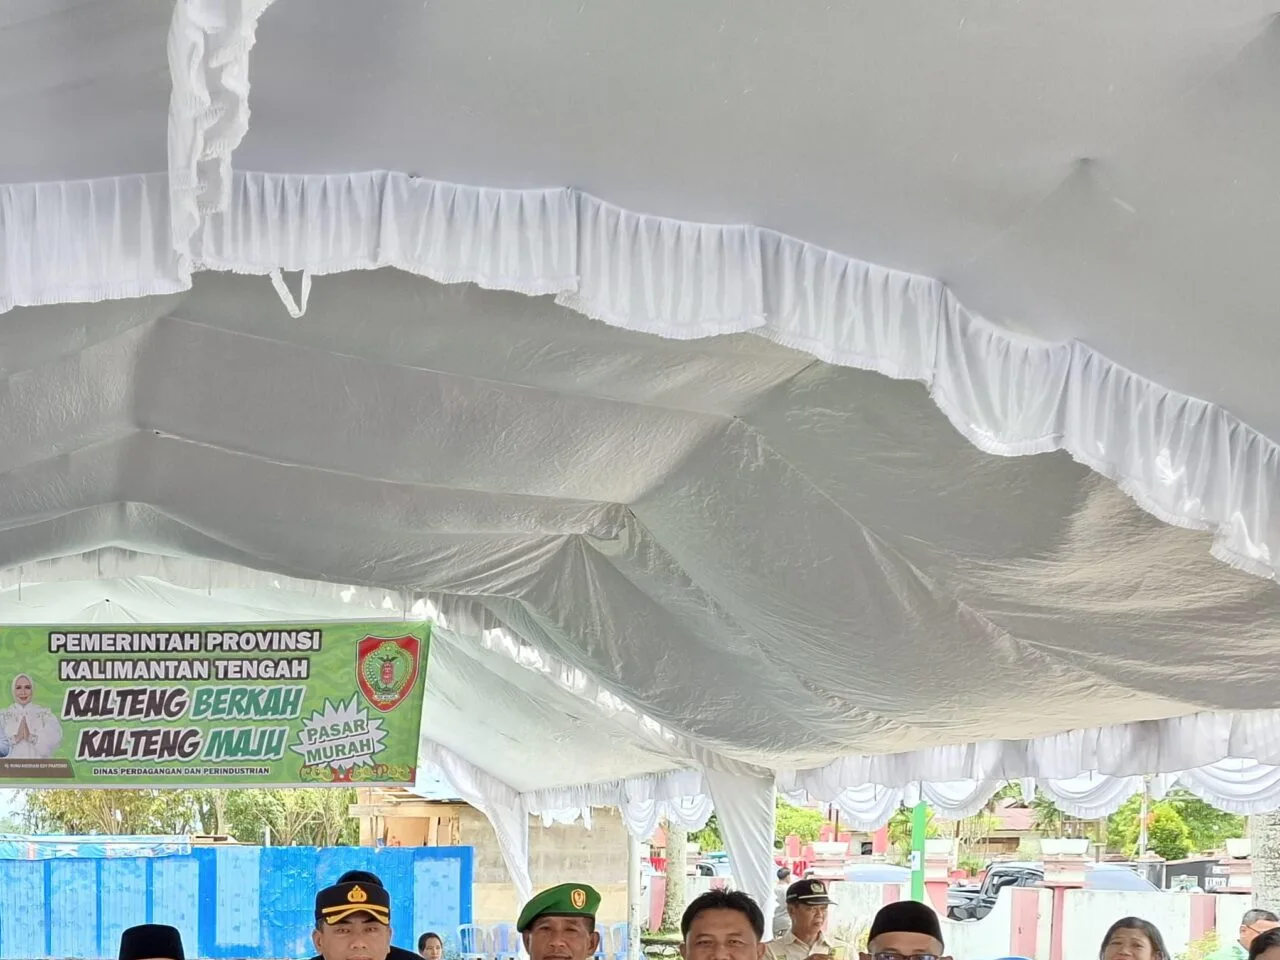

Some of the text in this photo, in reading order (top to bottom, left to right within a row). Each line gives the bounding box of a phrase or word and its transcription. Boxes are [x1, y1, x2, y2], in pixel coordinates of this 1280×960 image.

[50, 630, 321, 652] PEMERINTAH PROVINSI
[60, 659, 309, 680] KALIMANTAN TENGAH
[63, 687, 305, 718] KALTENG BERKAH
[307, 718, 368, 742] PASAR
[77, 727, 288, 759] KALTENG MAJU
[305, 738, 372, 765] MURAH
[93, 766, 270, 775] DINAS PERDAGANGAN DAN PERINDUSTRIAN
